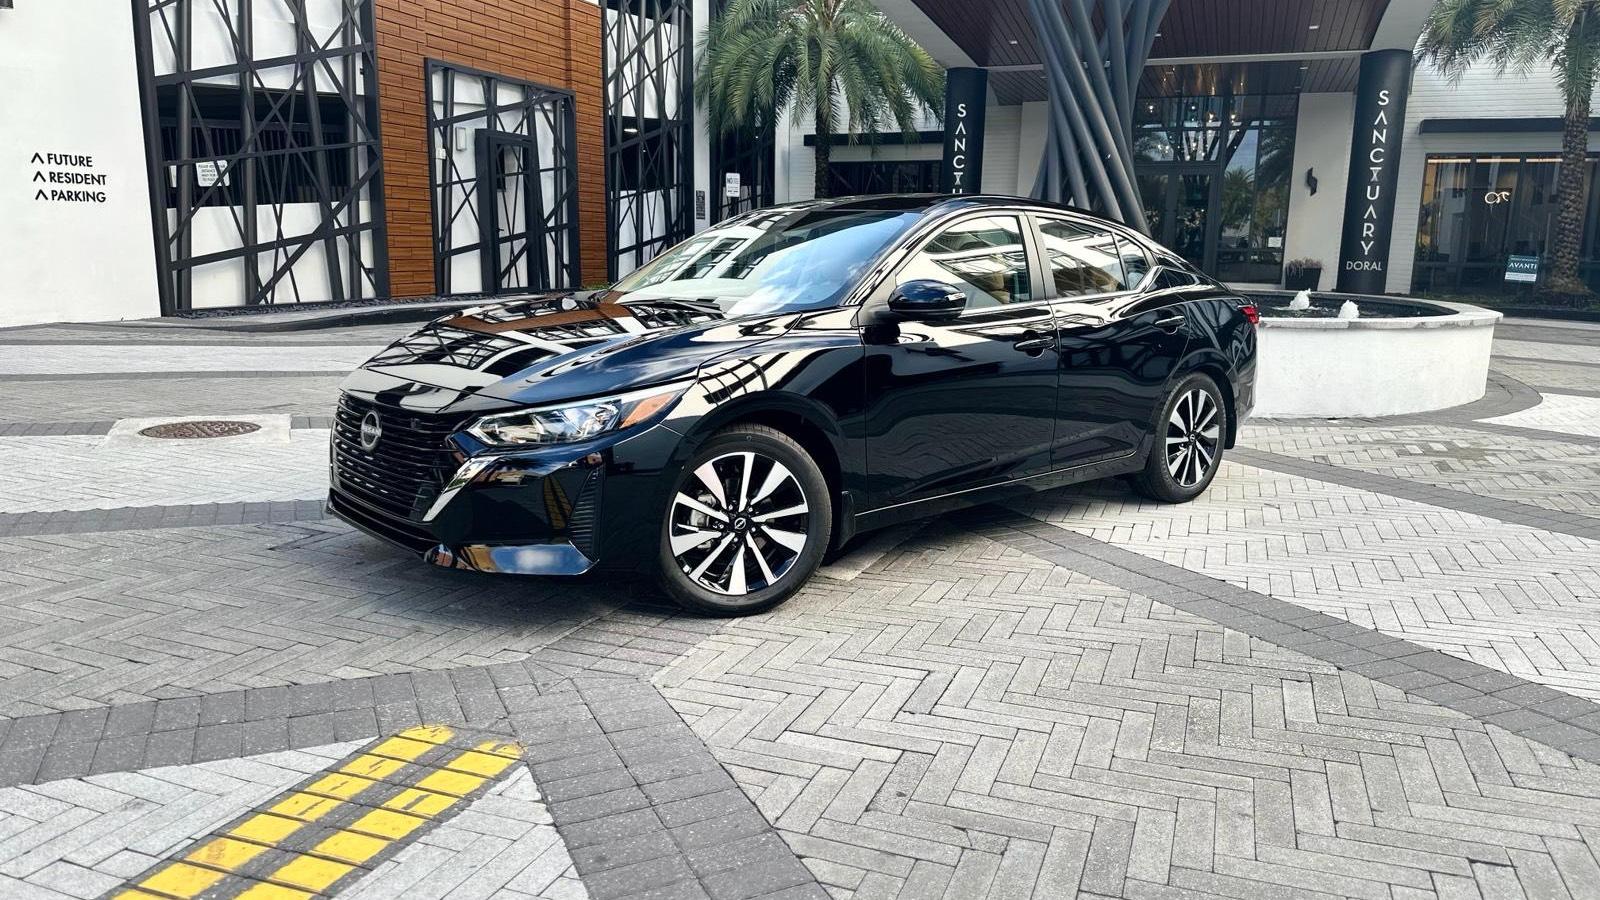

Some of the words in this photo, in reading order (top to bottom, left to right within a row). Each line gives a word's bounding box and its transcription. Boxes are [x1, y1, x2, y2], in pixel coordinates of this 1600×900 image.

[47, 153, 93, 168] FUTURE
[49, 171, 107, 186] RESIDENT
[1361, 90, 1390, 256] SANCTUARY
[51, 190, 107, 203] PARKING
[1346, 261, 1382, 271] DORAL
[1508, 262, 1537, 270] AVANTI
